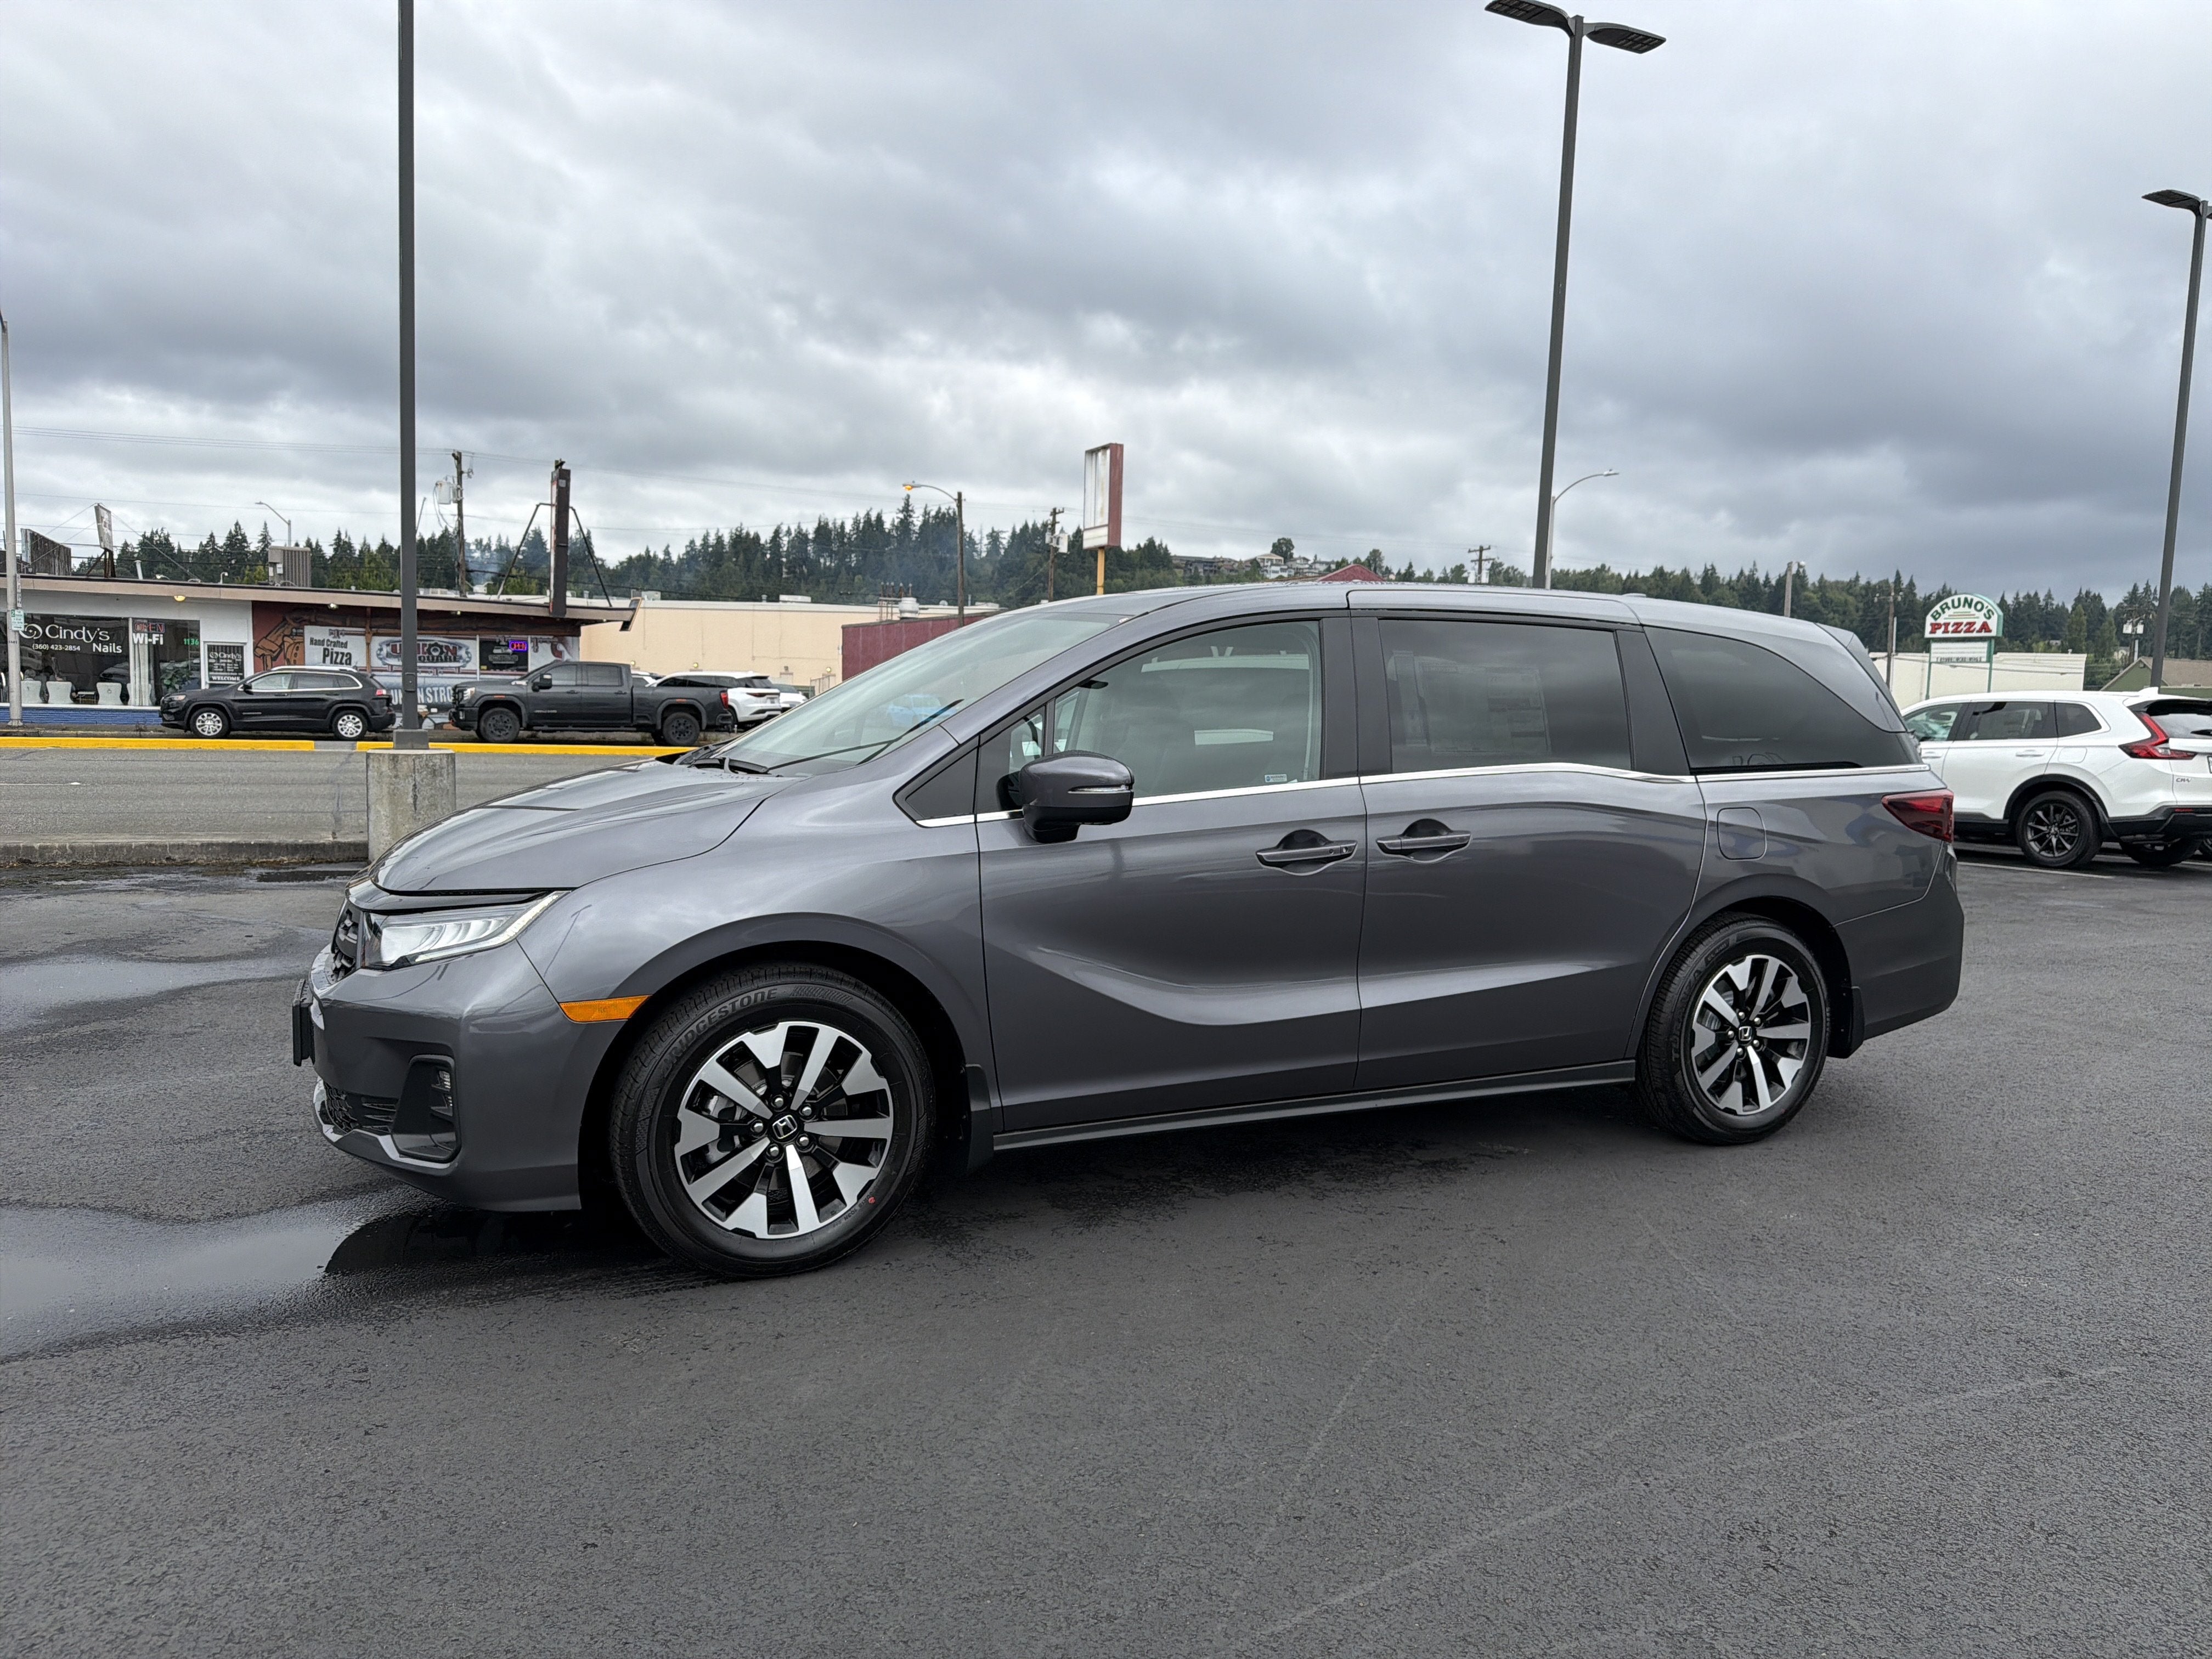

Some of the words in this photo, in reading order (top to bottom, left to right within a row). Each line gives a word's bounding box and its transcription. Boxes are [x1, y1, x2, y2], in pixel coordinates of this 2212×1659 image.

[1931, 597, 1995, 621] BRUNO'S
[46, 624, 110, 643] Cindy's
[135, 623, 164, 632] OPEN
[1929, 621, 1993, 634] PIZZA
[132, 633, 163, 645] Wi-Fi
[309, 637, 325, 646] Hand
[326, 639, 348, 649] Crafted
[93, 642, 122, 653] Nails
[322, 647, 352, 665] Pizza
[663, 988, 778, 1077] BRIDGESTONE
